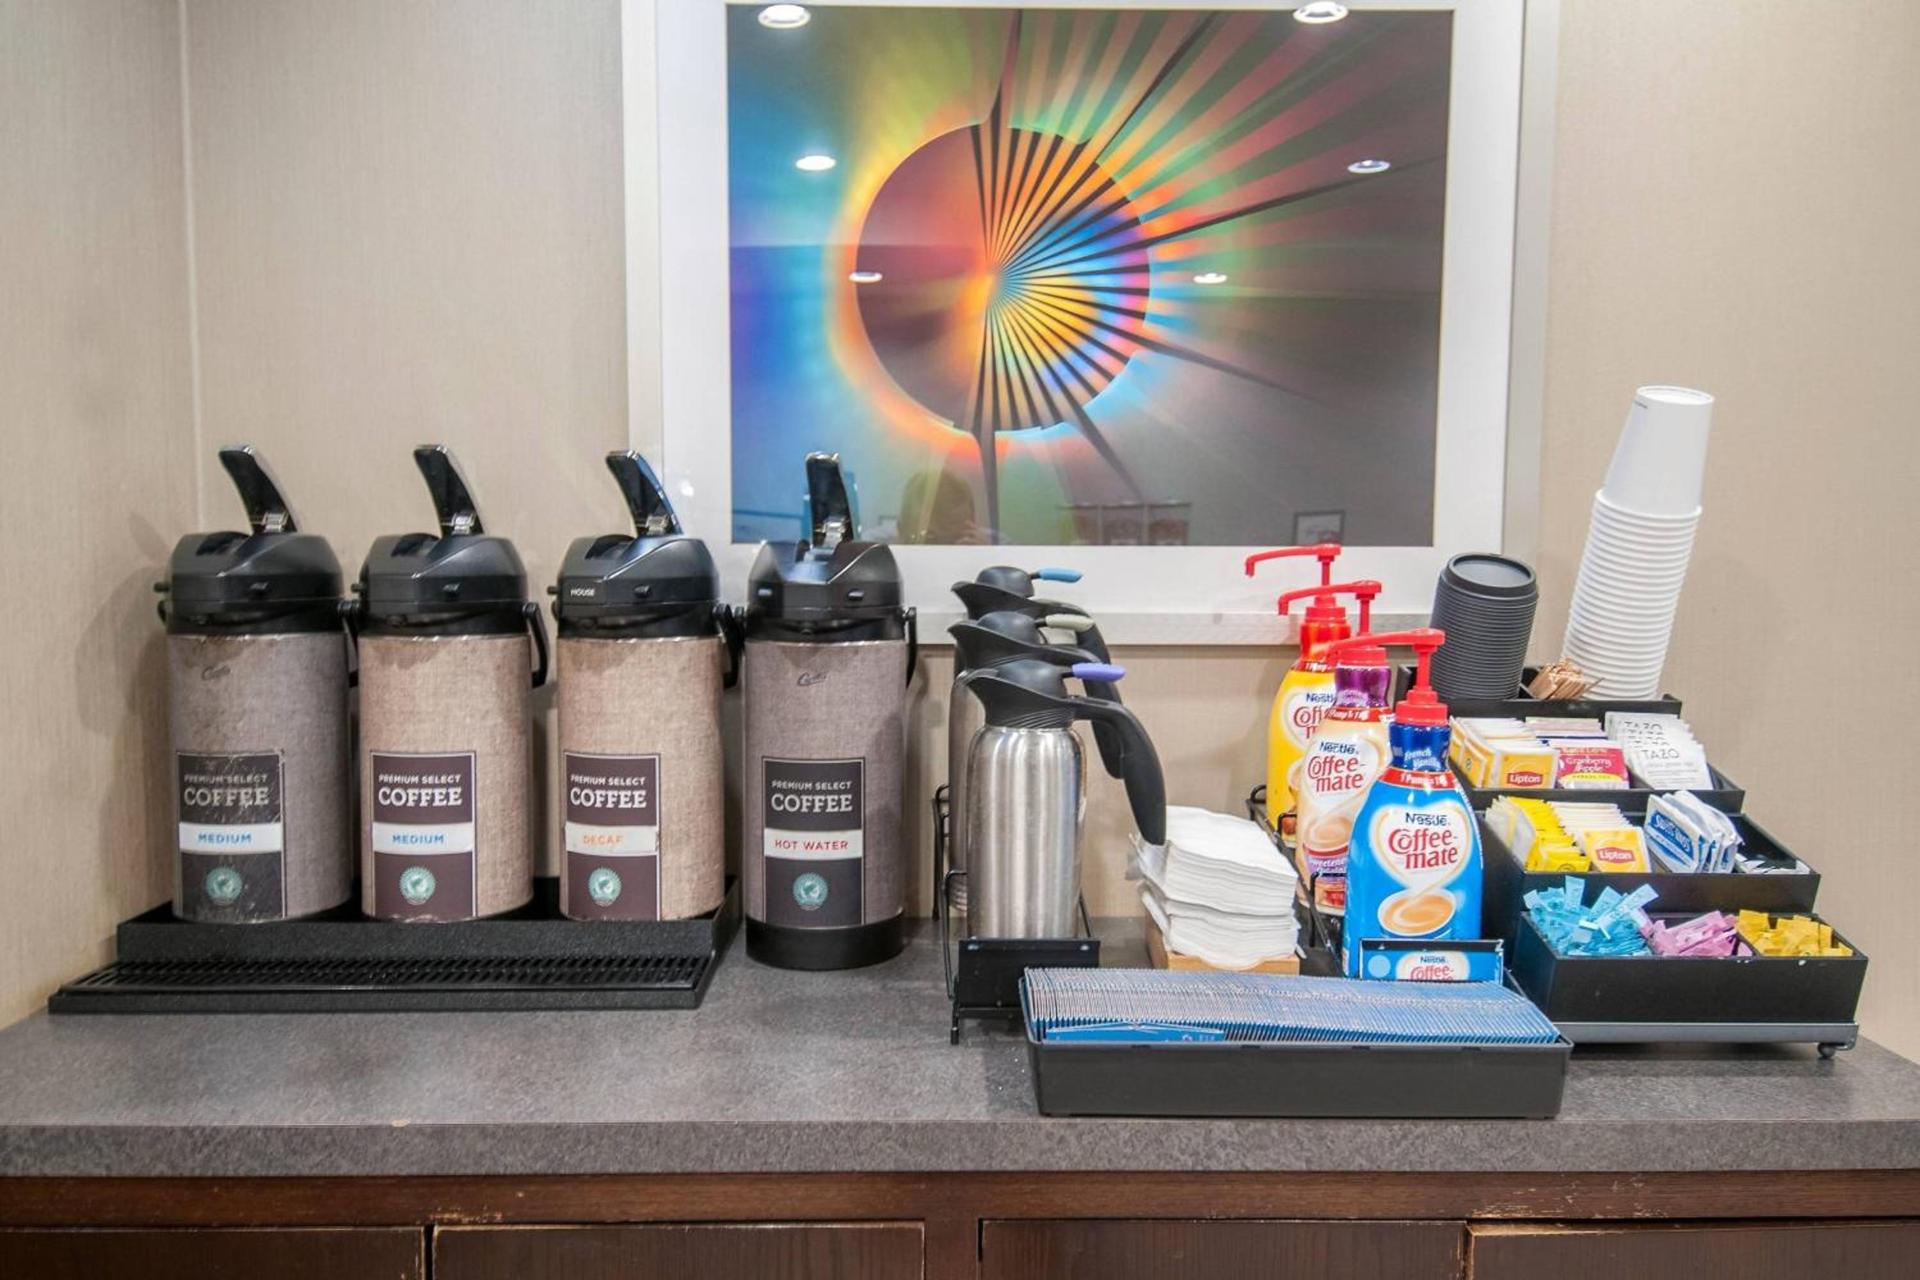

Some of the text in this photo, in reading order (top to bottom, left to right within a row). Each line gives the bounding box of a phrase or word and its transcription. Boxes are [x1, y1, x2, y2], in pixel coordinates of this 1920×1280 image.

[1306, 693, 1335, 703] Nestl
[1641, 748, 1680, 759] TAZO
[184, 774, 268, 784] PREMIUM SELECT
[378, 773, 461, 784] PREMIUM SELECT
[570, 773, 646, 786] PREMIUM SELECT
[1316, 773, 1364, 792] mate
[1510, 774, 1540, 784] Lipton
[772, 780, 852, 791] PREMIUM SELECT
[184, 786, 270, 807] COFFEE
[378, 786, 463, 807] COFFEE
[570, 787, 647, 808] COFFEE
[771, 793, 853, 813] COFFEE
[198, 833, 252, 844] MEDIUM
[392, 834, 444, 844] MEDIUM
[583, 834, 624, 845] DECAF
[775, 840, 849, 850] HOT WATER
[1405, 847, 1458, 869] mate
[1599, 850, 1632, 861] Lipton
